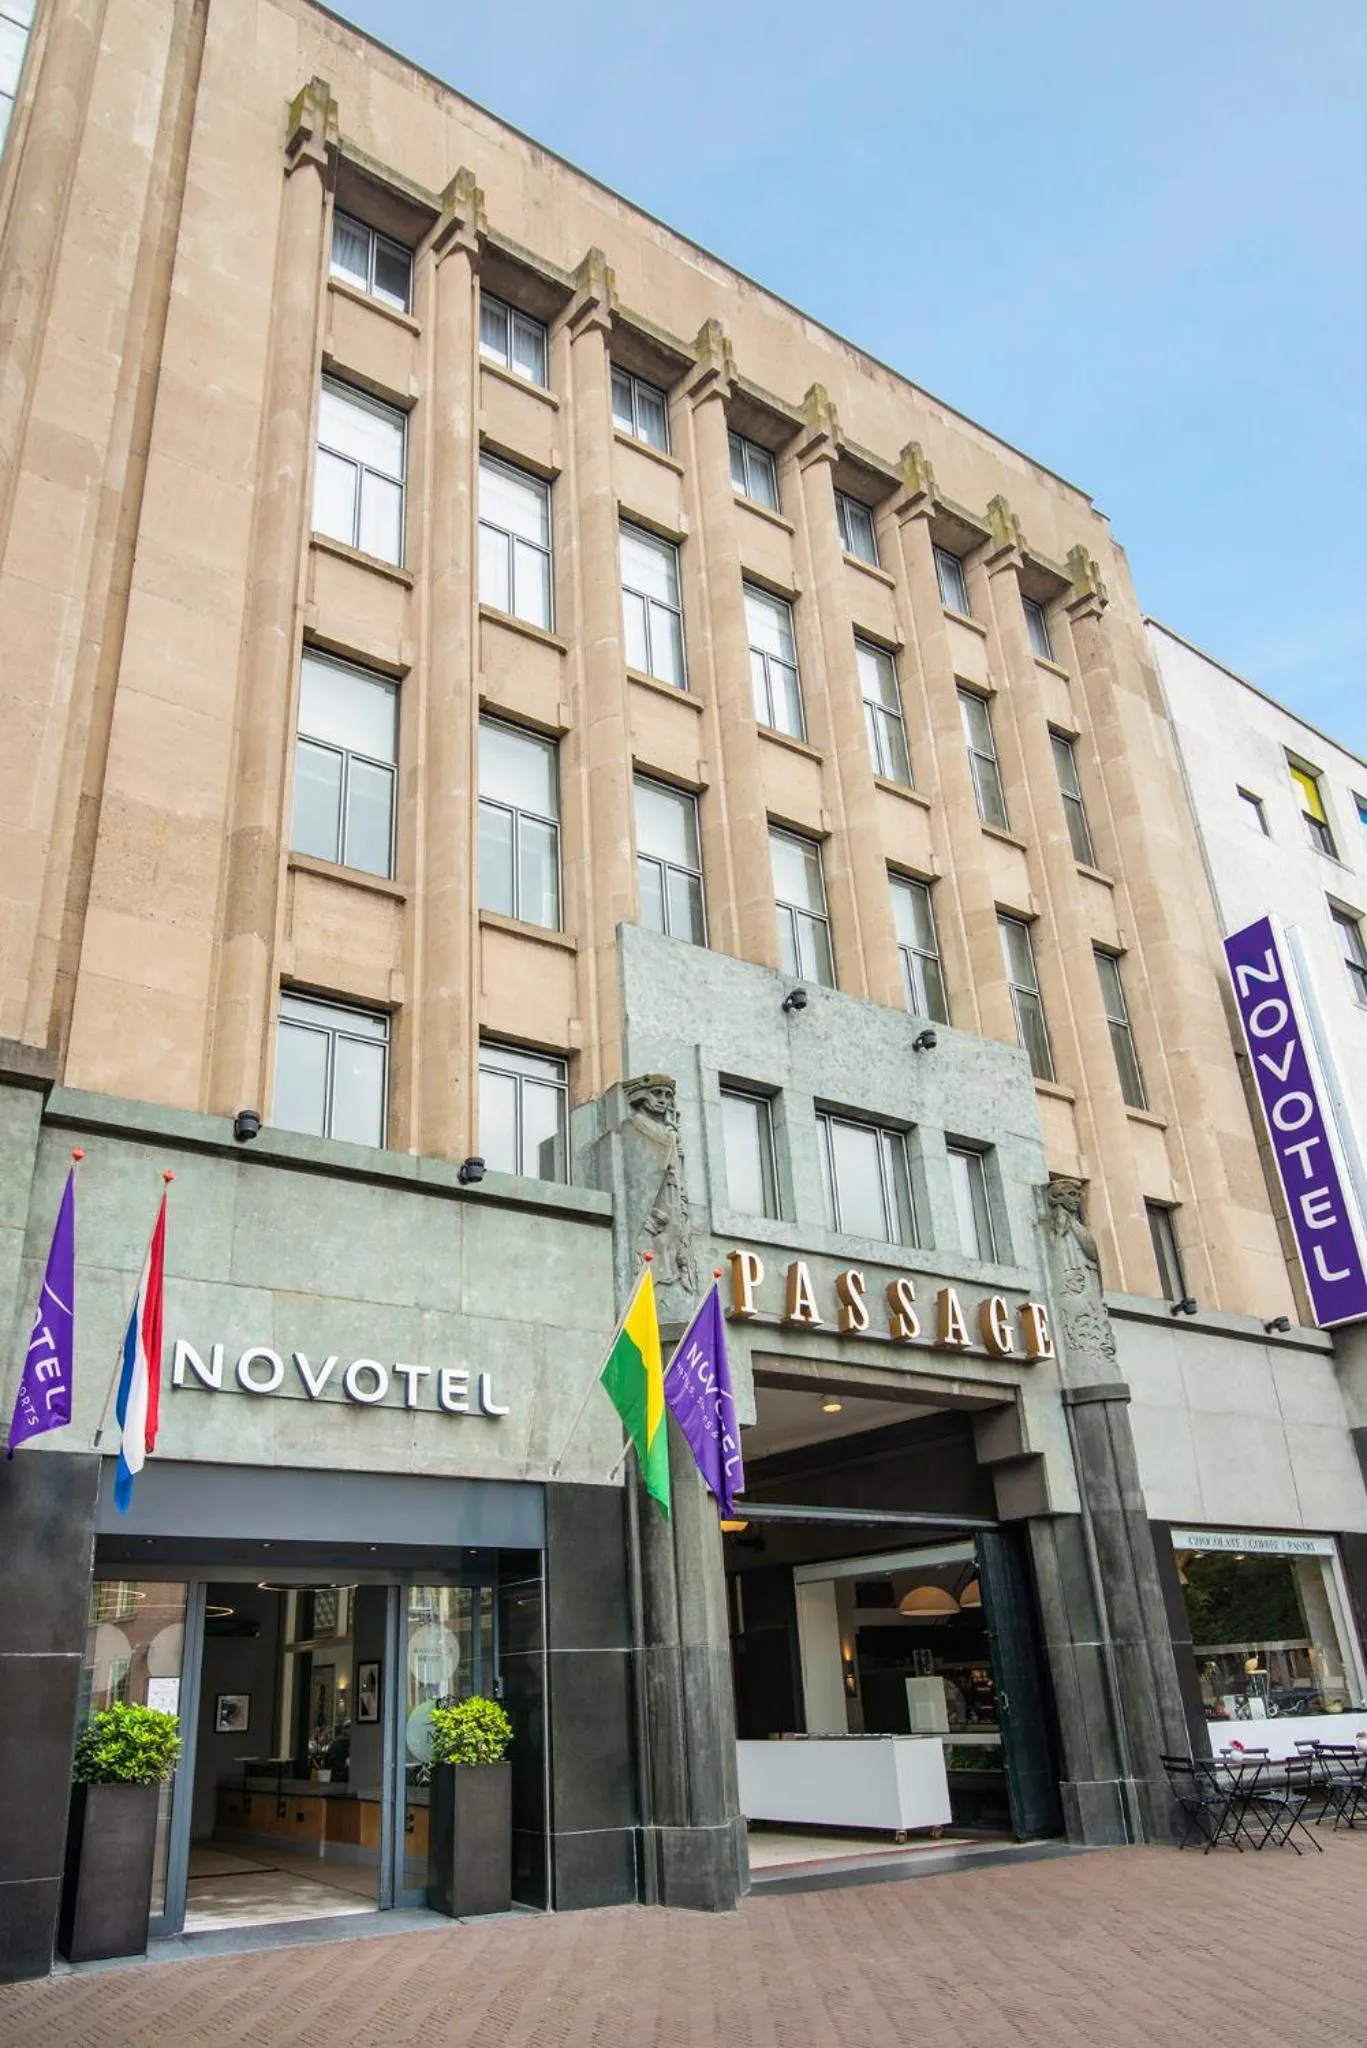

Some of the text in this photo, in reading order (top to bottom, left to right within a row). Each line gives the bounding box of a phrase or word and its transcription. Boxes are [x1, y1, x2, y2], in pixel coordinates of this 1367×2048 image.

[1235, 948, 1351, 1283] NOVOTEL
[728, 1250, 1055, 1361] PASSAGE
[172, 1339, 510, 1416] NOVOTEL
[686, 1341, 740, 1477] NOVOEL
